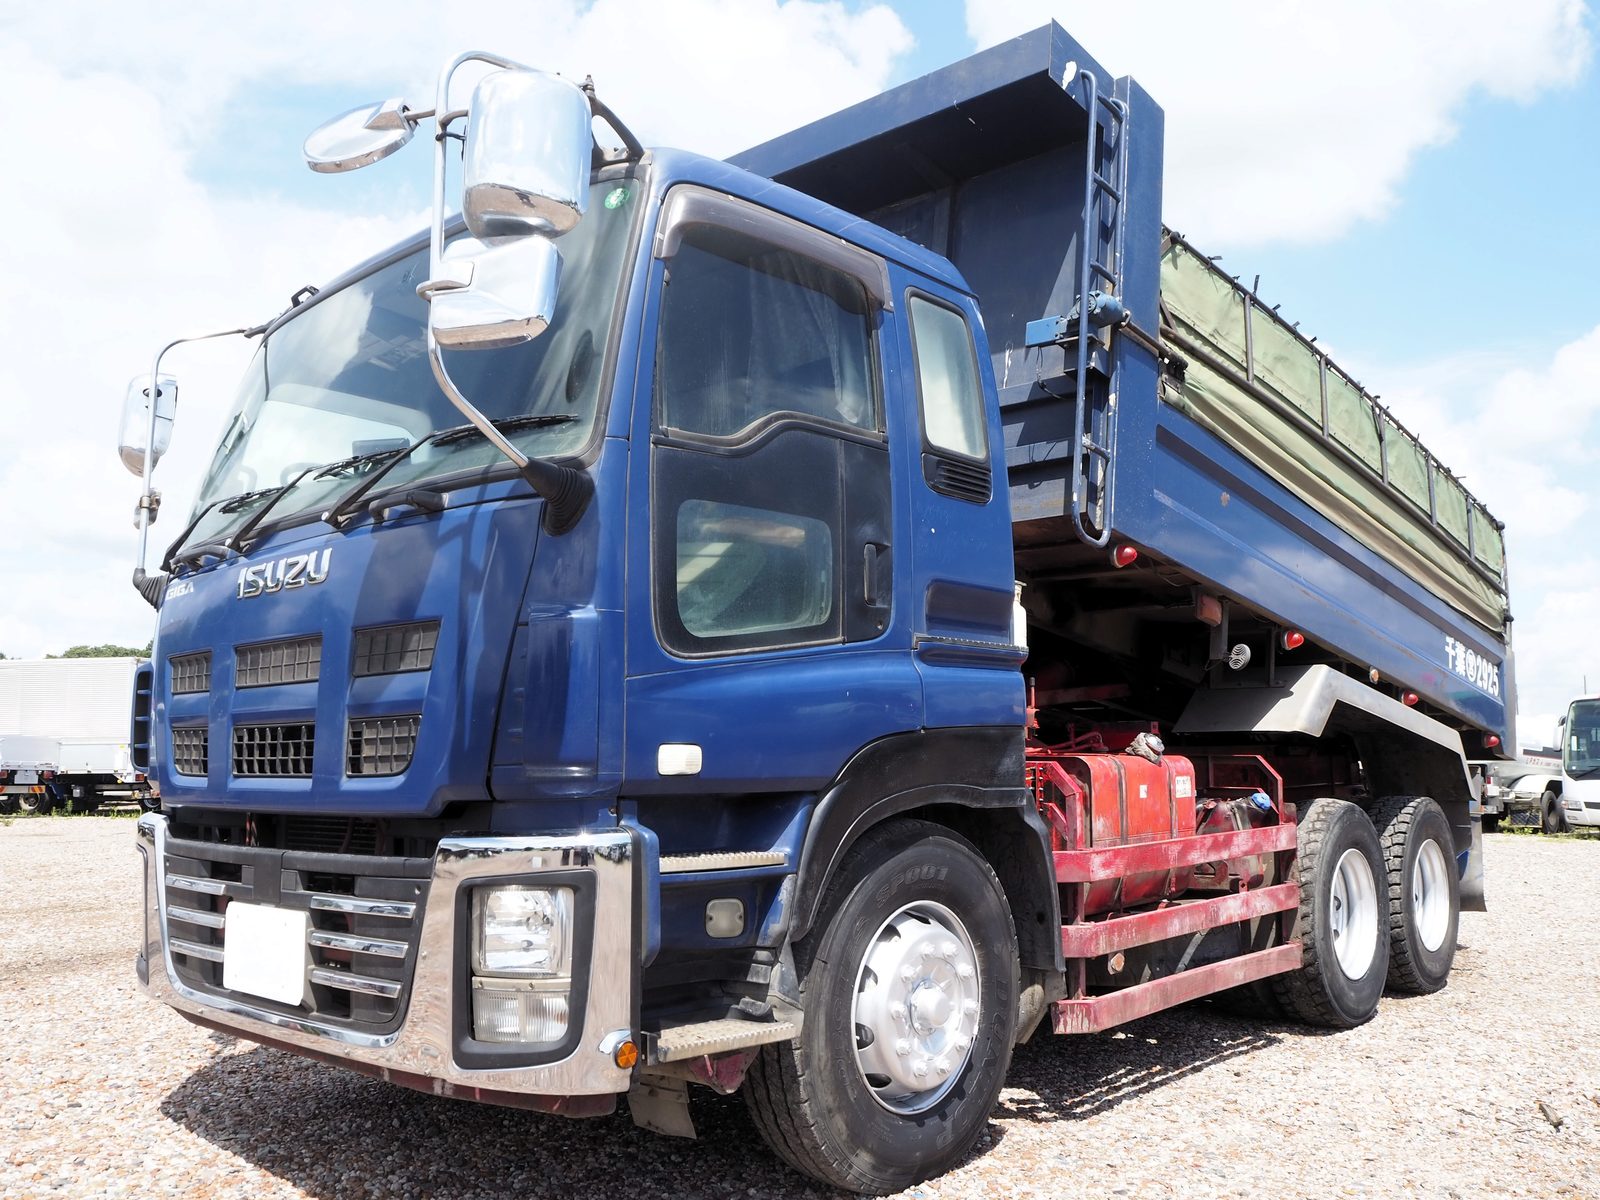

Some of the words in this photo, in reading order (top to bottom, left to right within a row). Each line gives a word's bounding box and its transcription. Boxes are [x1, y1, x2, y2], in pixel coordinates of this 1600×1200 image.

[165, 581, 194, 601] GIGA
[236, 547, 333, 600] ISUZU
[876, 864, 949, 908] SP001
